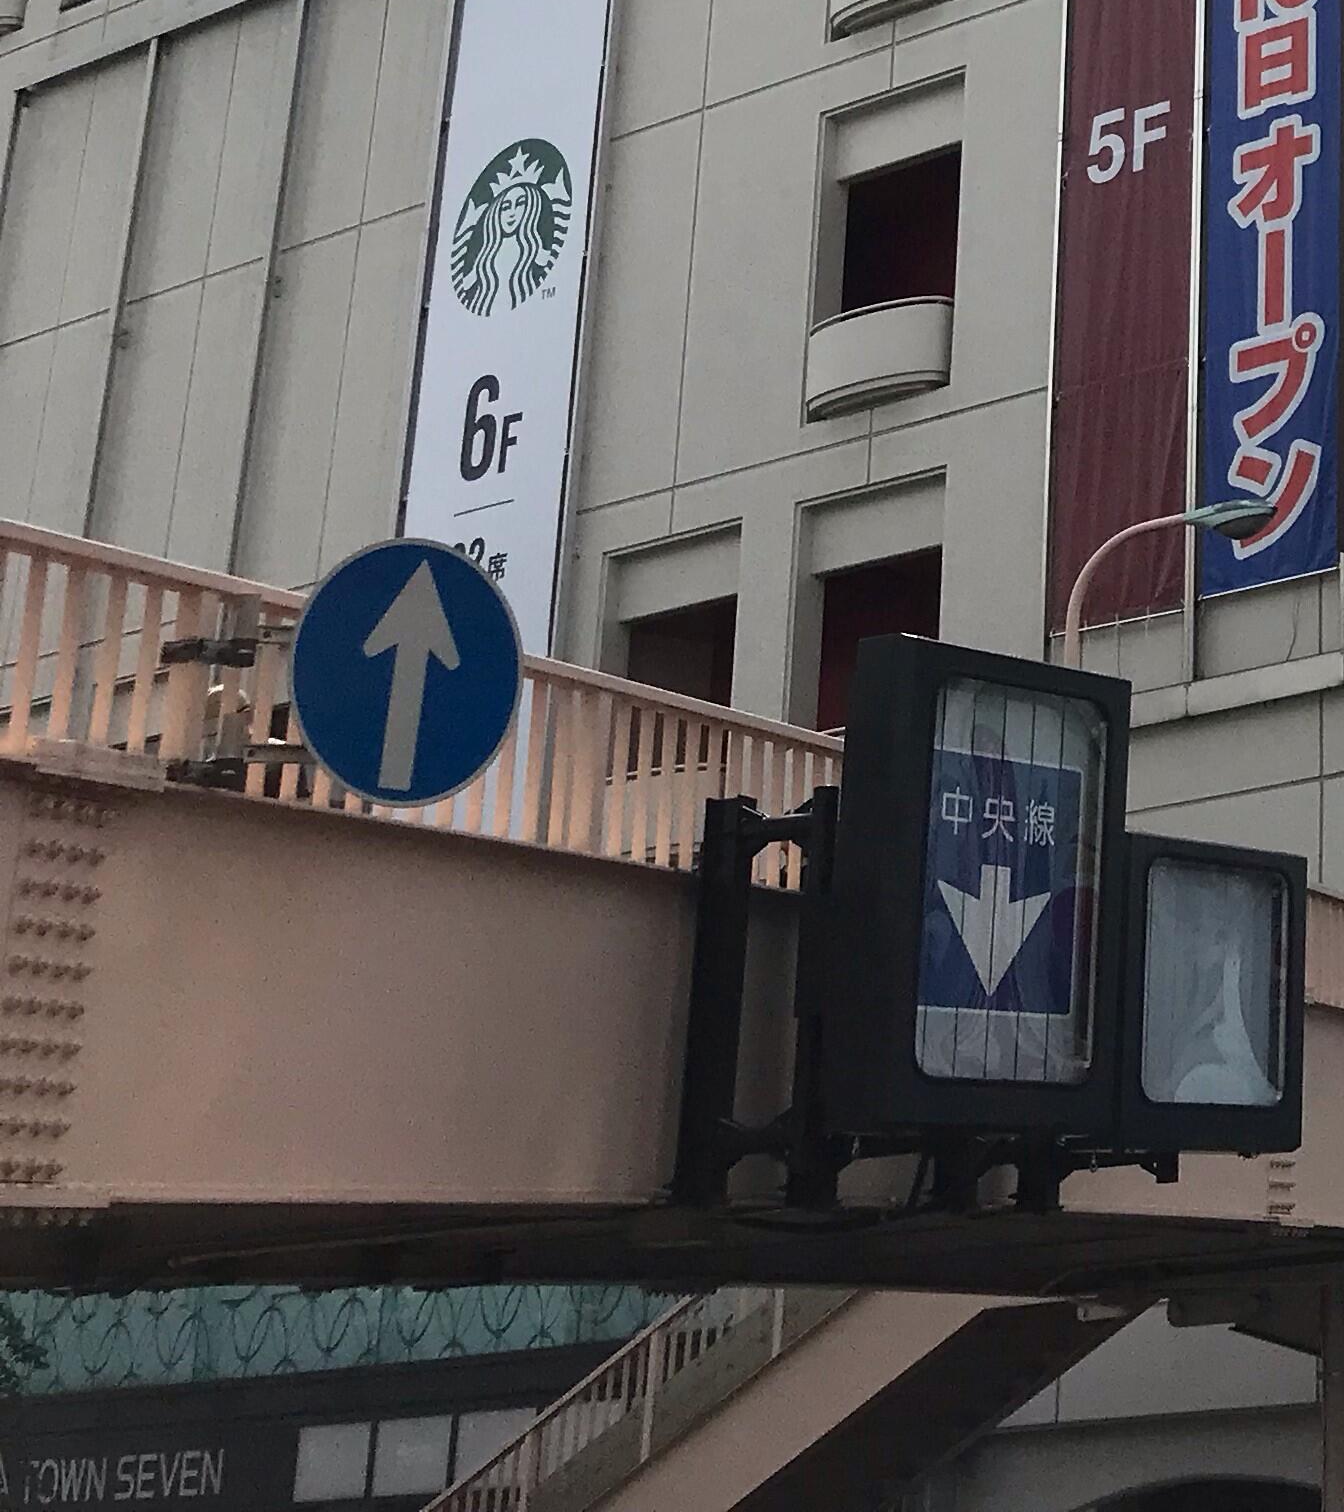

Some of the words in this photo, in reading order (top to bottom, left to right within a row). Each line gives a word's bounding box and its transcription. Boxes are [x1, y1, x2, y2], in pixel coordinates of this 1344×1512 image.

[1086, 99, 1171, 185] 5F
[459, 374, 523, 482] 6F
[940, 786, 1056, 848] 中央線
[113, 1448, 225, 1502] SEVEN
